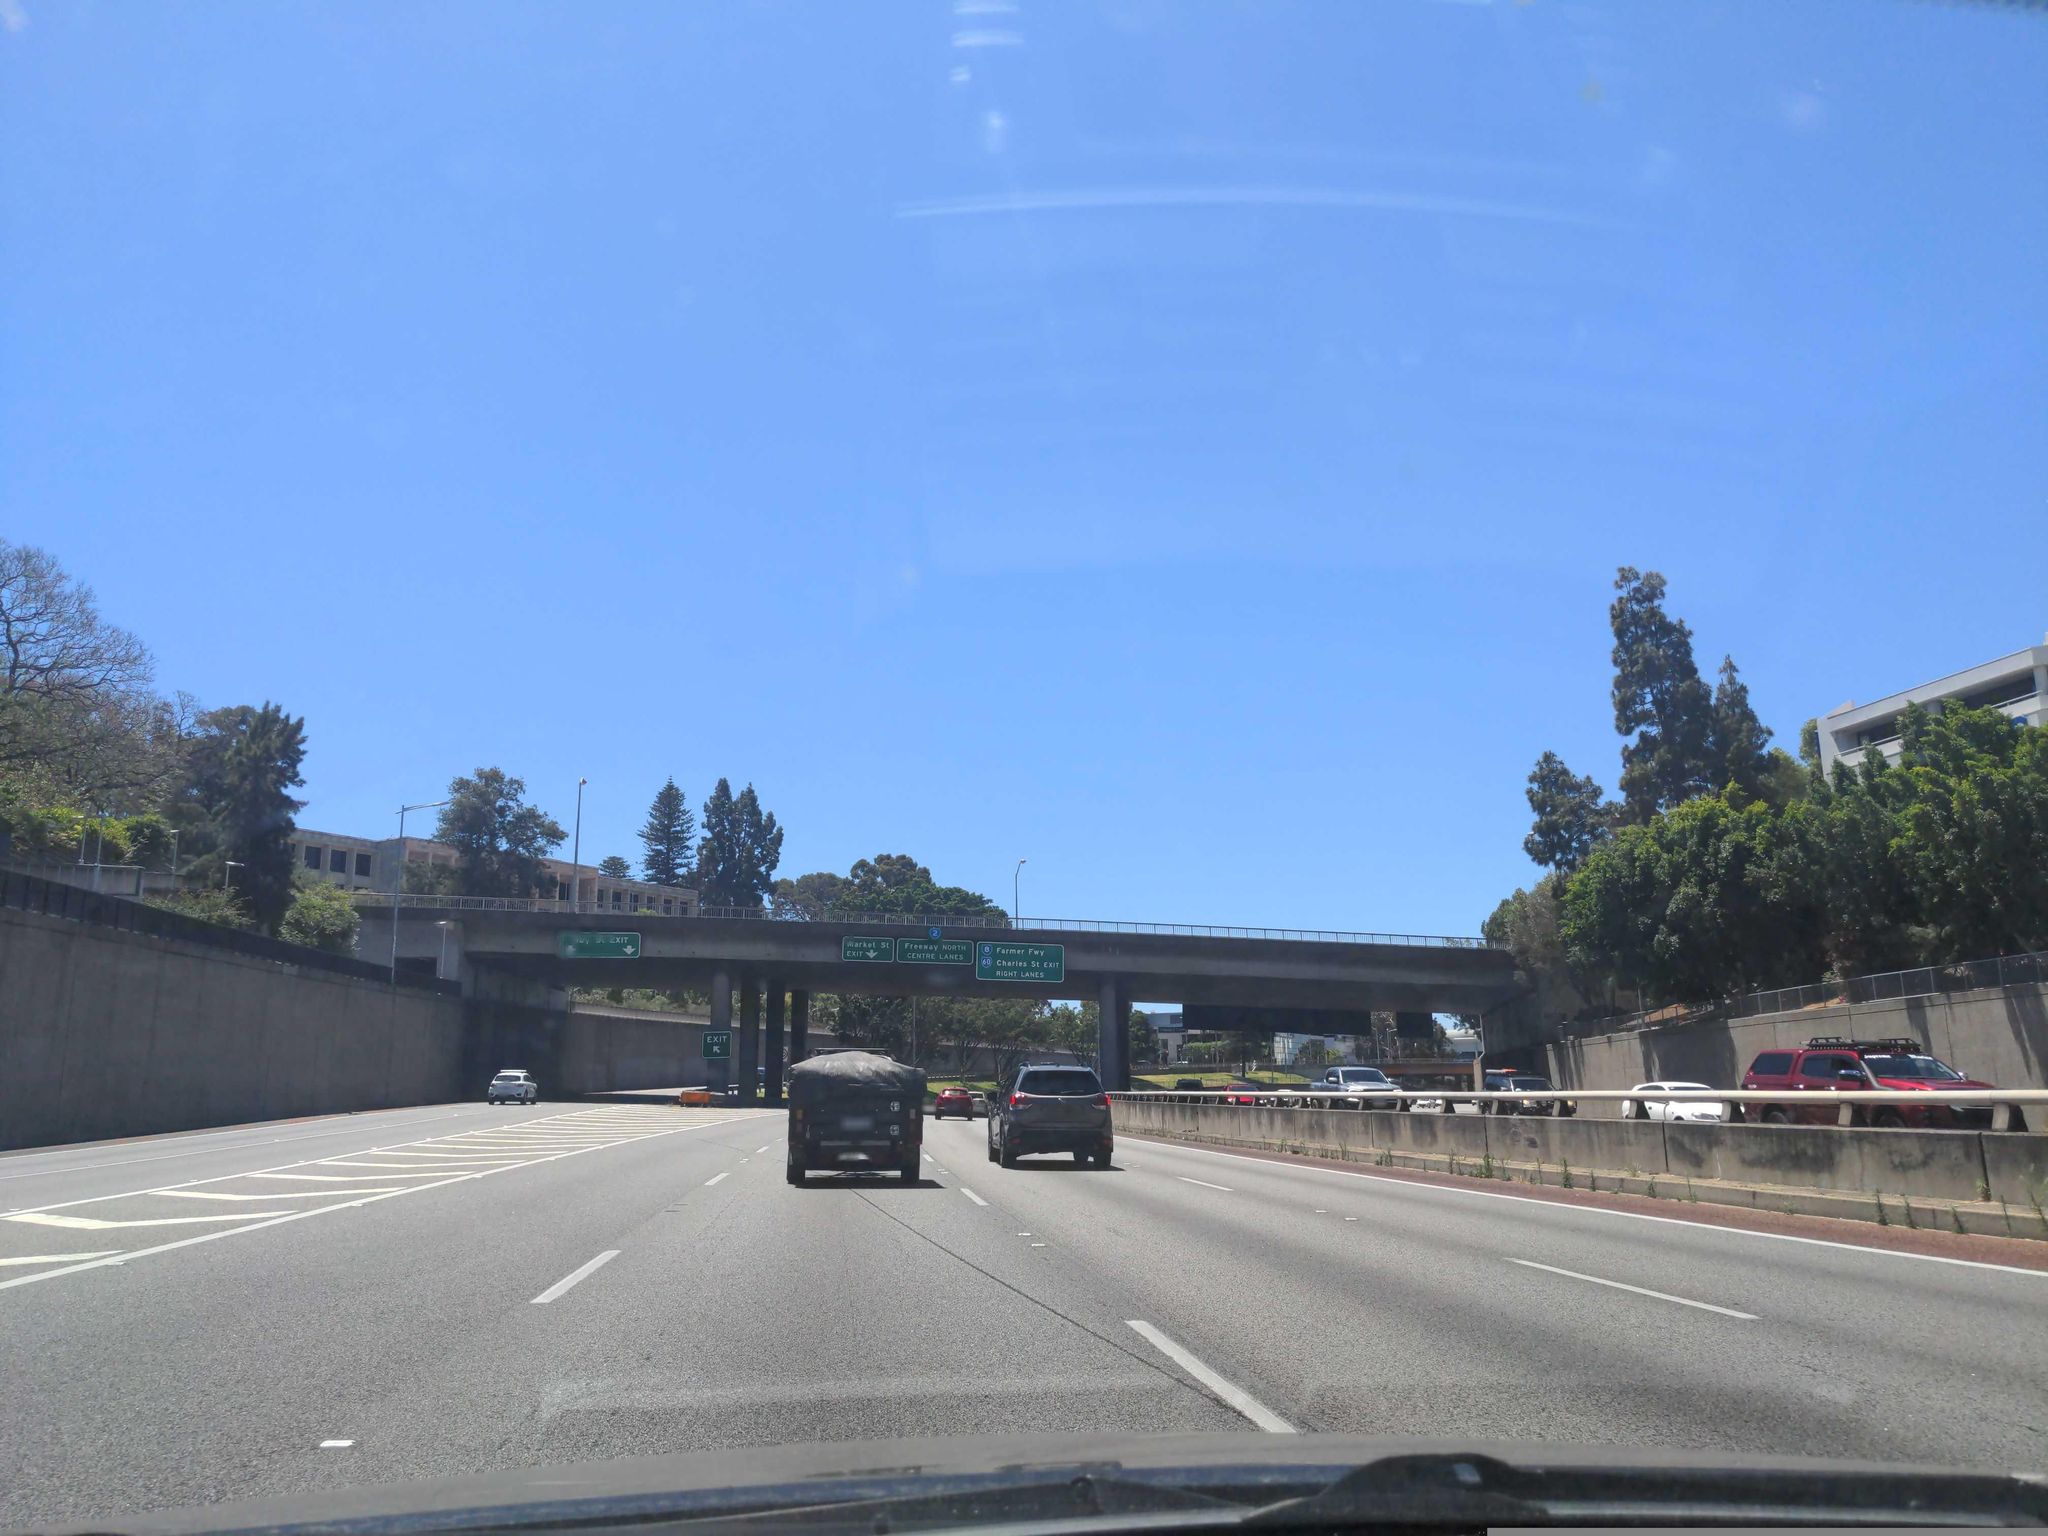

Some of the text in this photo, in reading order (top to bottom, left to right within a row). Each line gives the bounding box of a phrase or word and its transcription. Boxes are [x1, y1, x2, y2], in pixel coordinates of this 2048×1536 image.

[609, 936, 629, 944] EXIT
[905, 943, 938, 951] Freeway
[907, 952, 936, 960] CENTRE
[1028, 948, 1045, 956] Fwy
[996, 959, 1027, 967] Charles
[706, 1035, 728, 1043] EXIT
